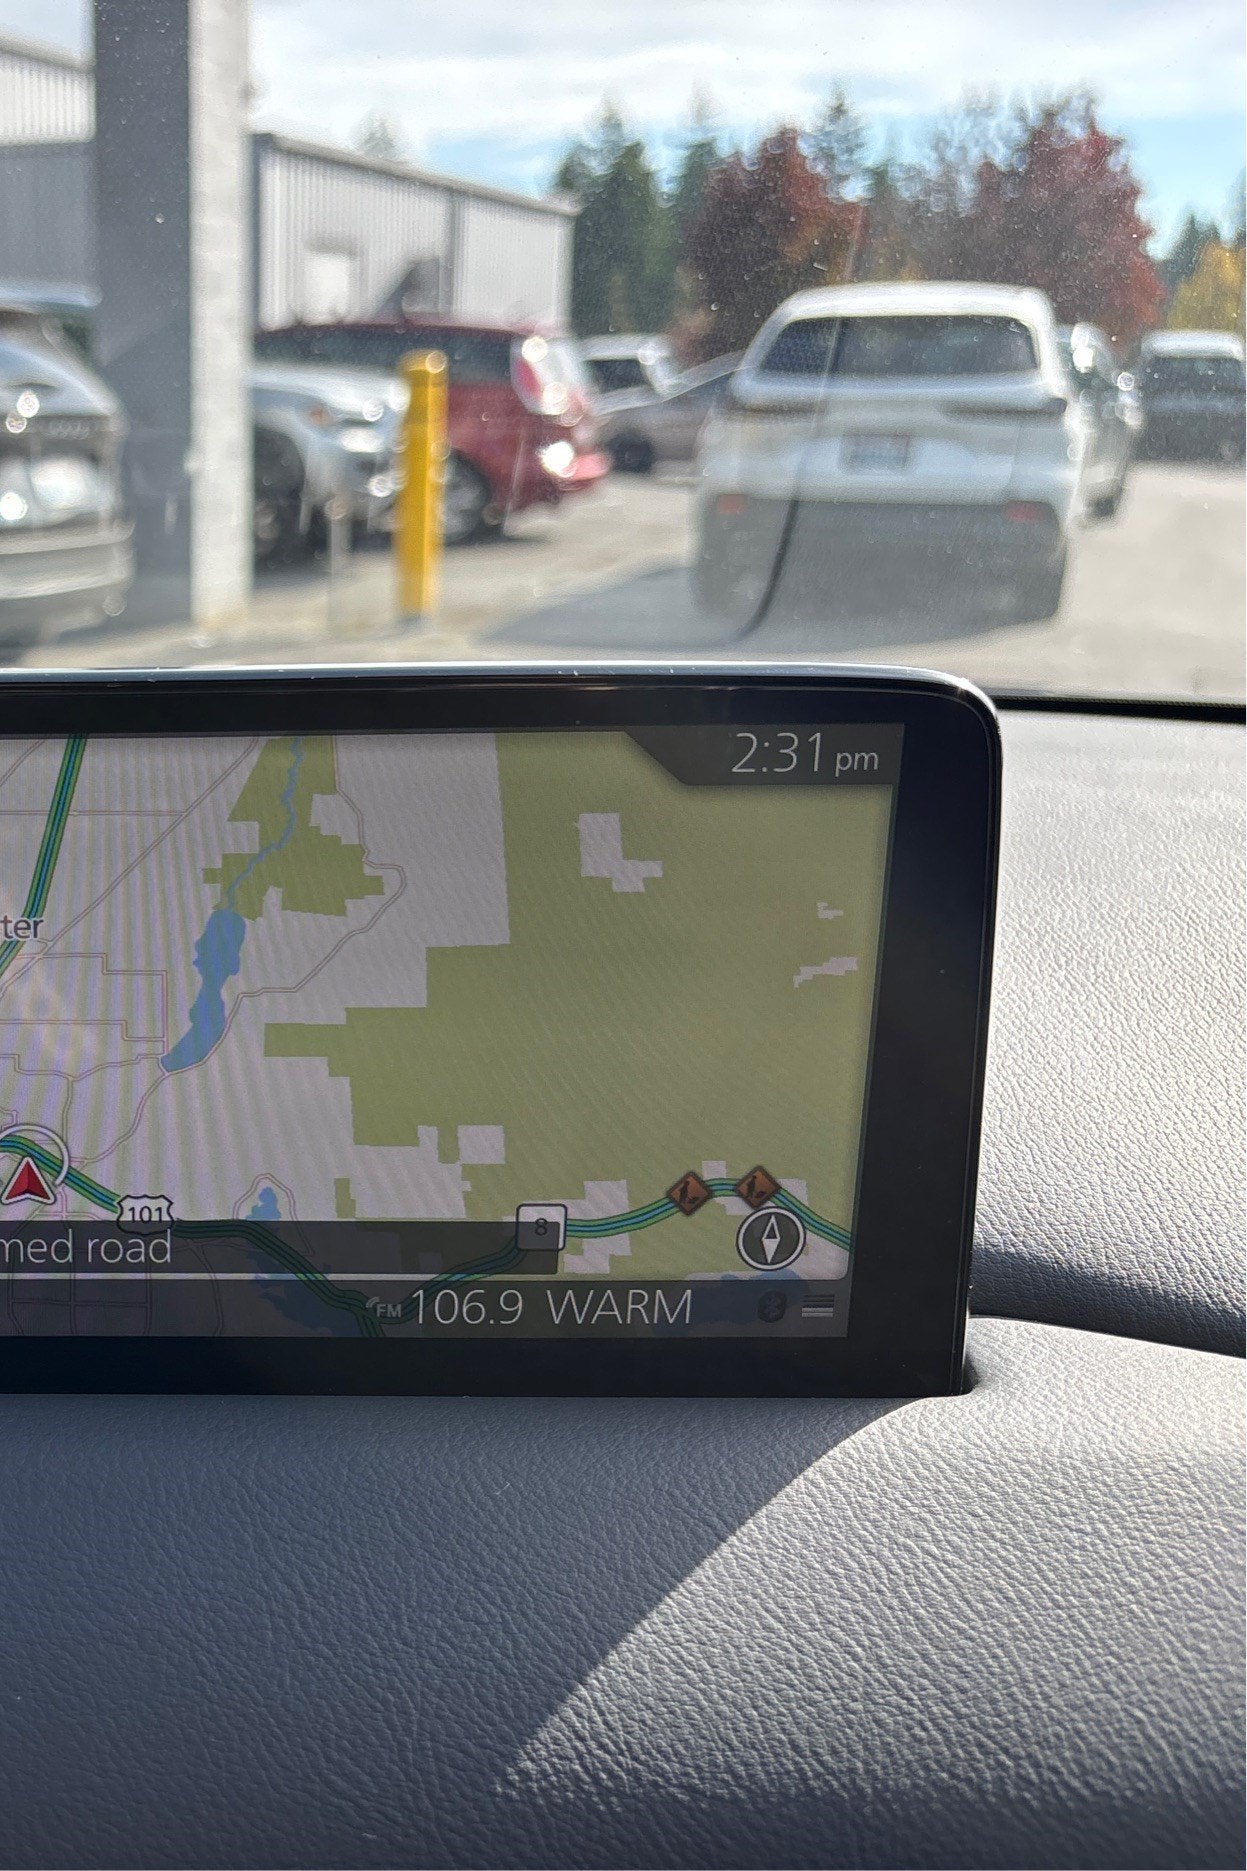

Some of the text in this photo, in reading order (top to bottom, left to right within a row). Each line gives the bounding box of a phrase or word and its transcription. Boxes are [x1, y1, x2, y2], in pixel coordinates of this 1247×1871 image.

[731, 731, 879, 777] 2:31 pm
[127, 1205, 164, 1225] 101
[534, 1217, 549, 1236] 8
[87, 1229, 172, 1265] road
[376, 1289, 694, 1326] FM 106.9 WARM
